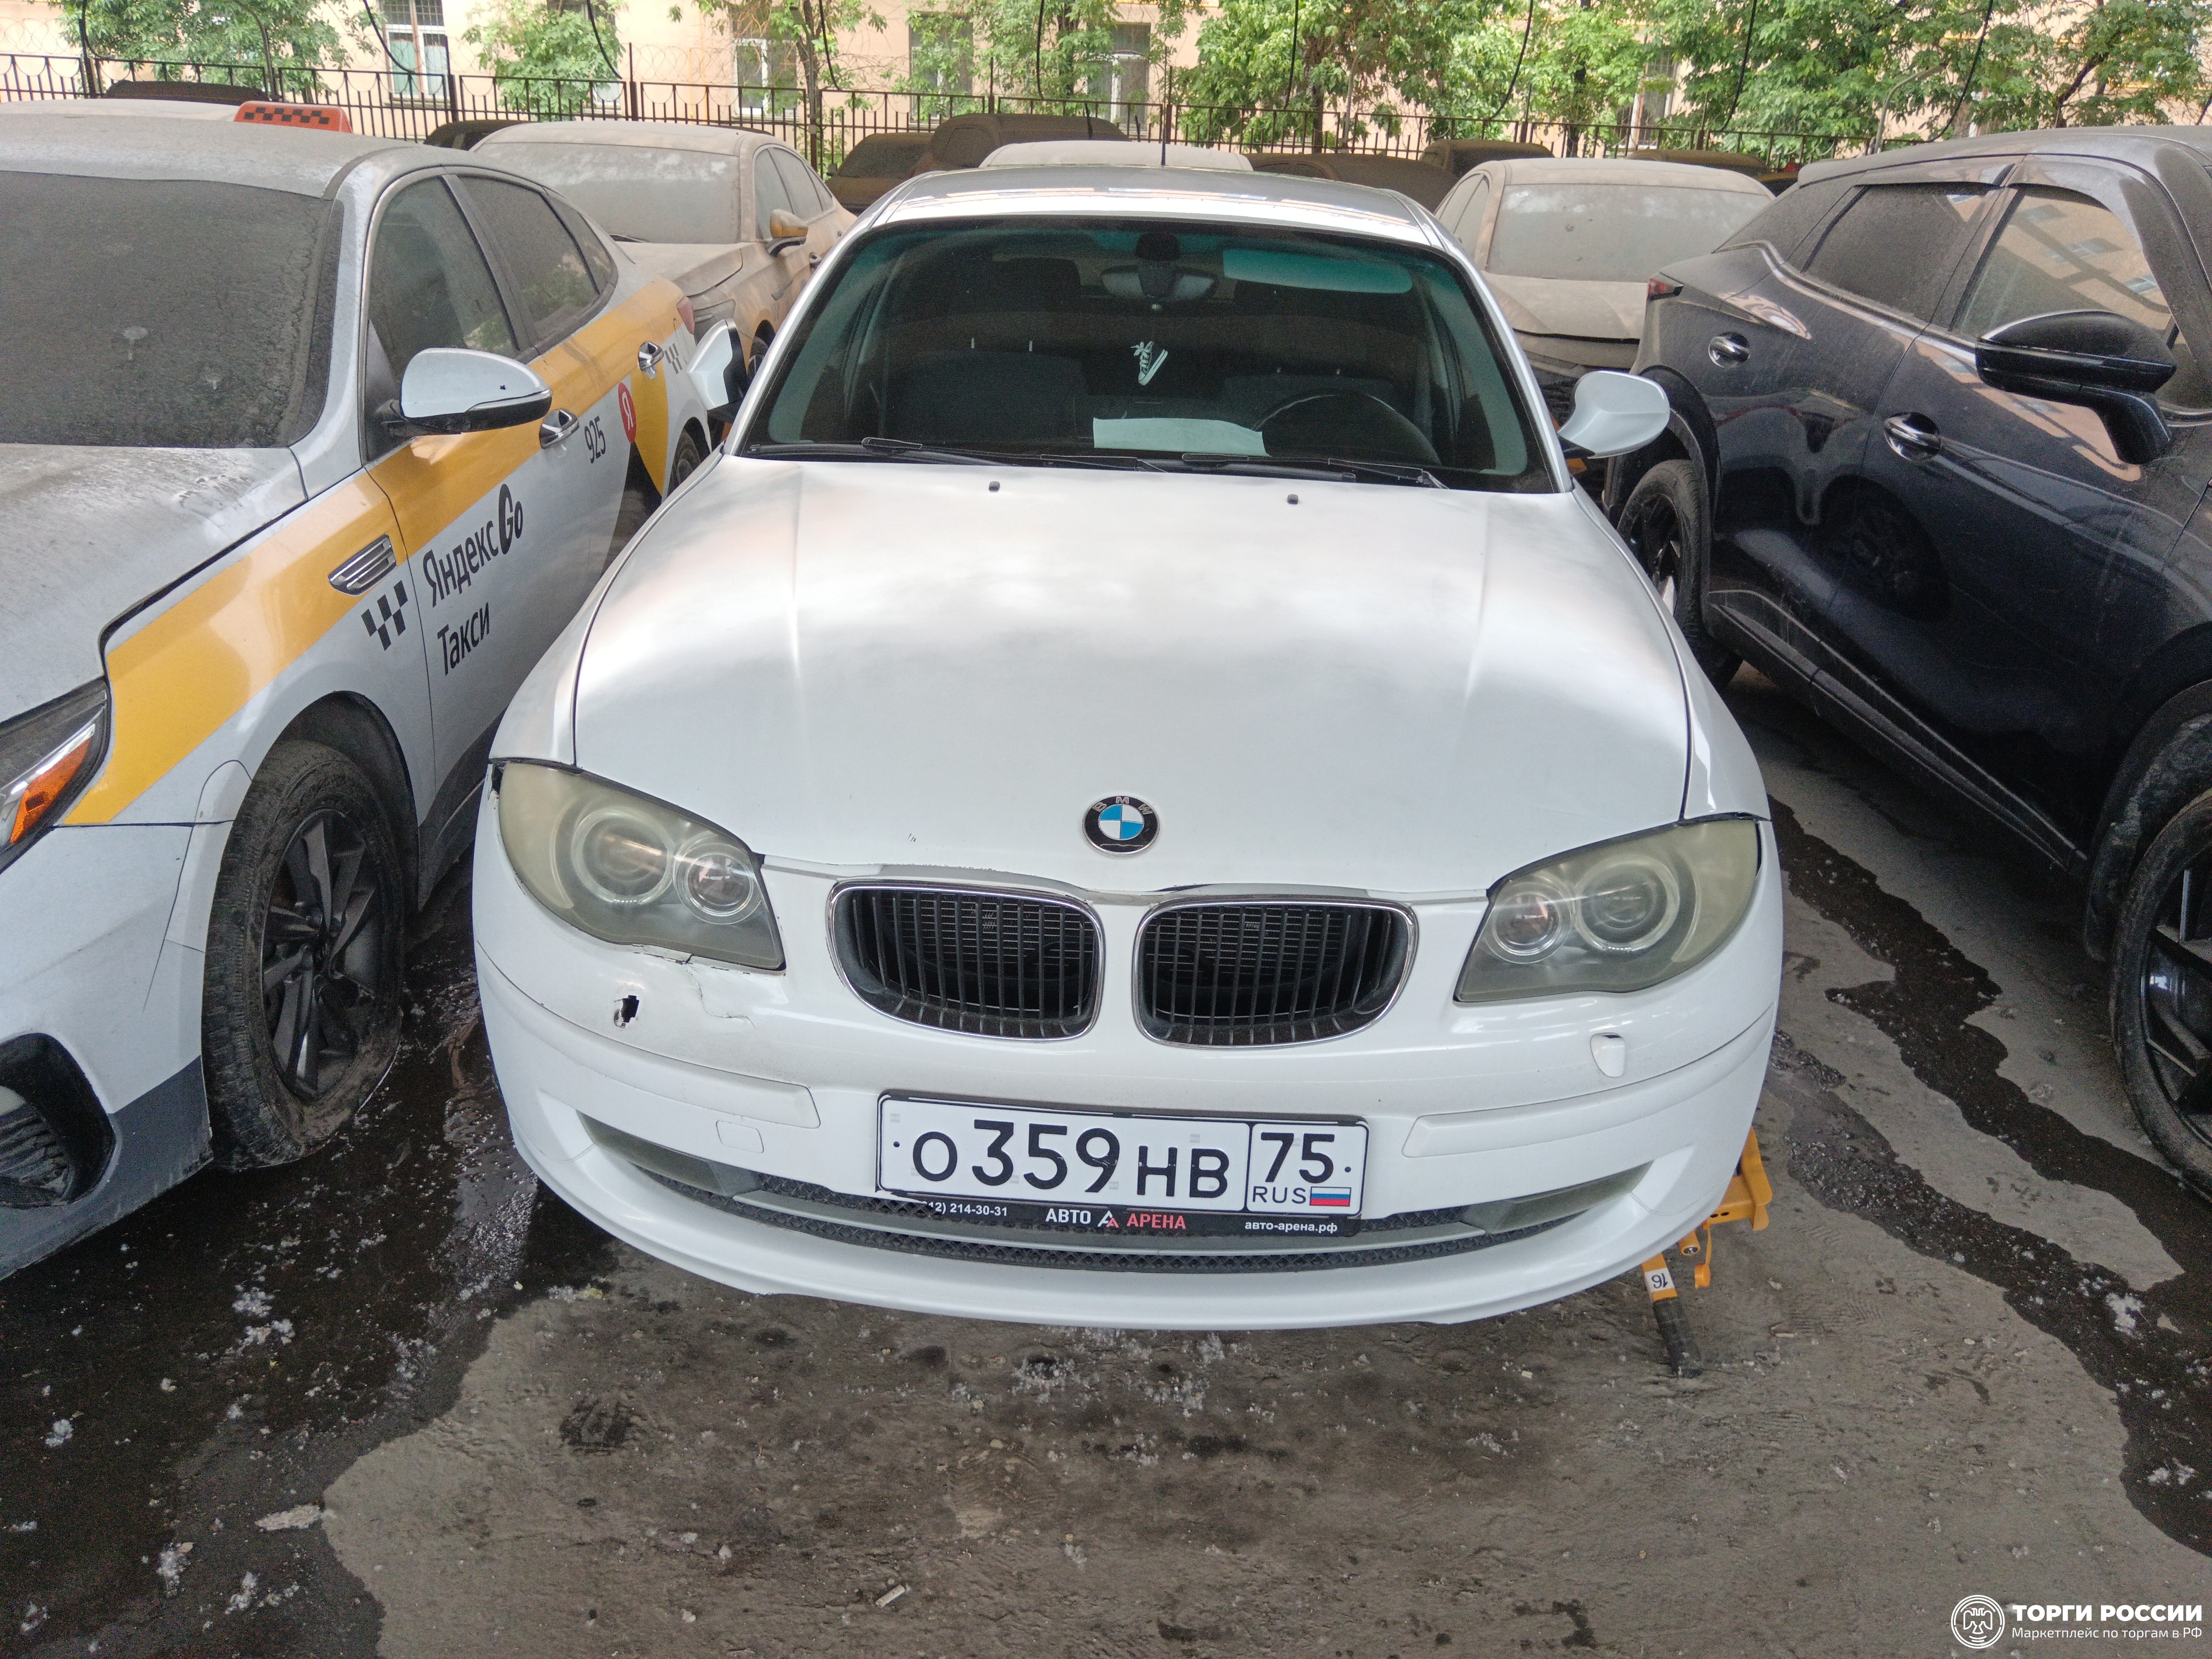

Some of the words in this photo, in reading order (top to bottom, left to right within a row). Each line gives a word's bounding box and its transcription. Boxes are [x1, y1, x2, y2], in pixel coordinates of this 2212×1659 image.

[622, 391, 633, 430] Я
[584, 415, 606, 464] 925
[422, 520, 499, 608] Яндекс
[498, 483, 523, 555] Go
[437, 602, 490, 676] Такси
[1092, 796, 1153, 814] BMW
[1261, 1132, 1335, 1184] 75
[950, 1203, 1007, 1216] 214-30-31
[1252, 1186, 1306, 1204] RUS
[1045, 1208, 1091, 1224] АВТО
[1127, 1212, 1186, 1230] АРЕНА
[1245, 1221, 1338, 1234] авто-арена.рф
